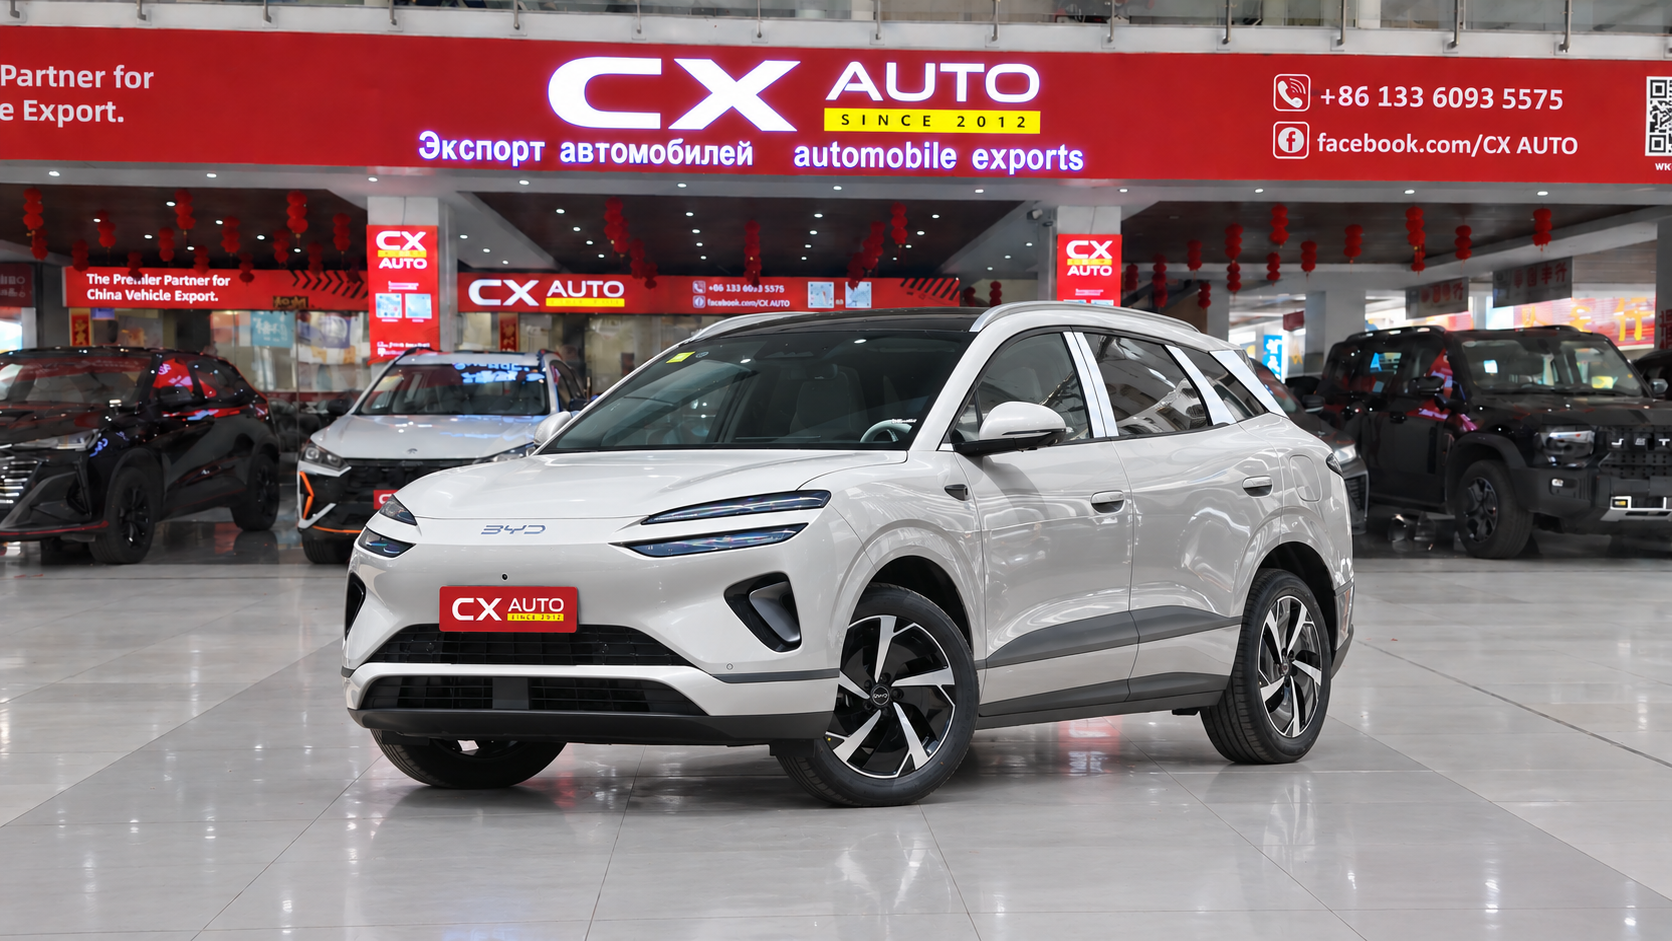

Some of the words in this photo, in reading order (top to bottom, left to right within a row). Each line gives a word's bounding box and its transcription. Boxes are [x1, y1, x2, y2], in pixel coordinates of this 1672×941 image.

[0, 64, 106, 89] Partner
[113, 64, 155, 89] for
[547, 56, 801, 132] CX
[825, 61, 1040, 103] AUTO
[1320, 85, 1370, 108] +86
[1378, 85, 1424, 108] 133
[1432, 86, 1494, 109] 6093
[1502, 88, 1563, 110] 5575
[23, 99, 124, 128] Export.
[841, 114, 932, 127] SINCE
[957, 115, 1027, 128] 2012
[418, 131, 545, 168] Экспорт
[559, 138, 754, 166] автомобилей
[1317, 132, 1511, 158] facebook.com/CX
[1517, 136, 1578, 155] AUTO
[794, 141, 957, 170] automobile
[971, 144, 1084, 176] exports
[375, 230, 427, 251] CX
[1066, 240, 1113, 259] CX
[378, 257, 428, 270] AUTO
[1066, 265, 1113, 277] AUTO
[87, 274, 111, 286] The
[164, 275, 209, 288] Partner
[212, 275, 231, 287] for
[468, 279, 540, 307] CX
[546, 280, 625, 298] AUTO
[87, 288, 123, 301] China
[126, 289, 172, 302] Vehicle
[174, 291, 219, 305] Export.
[481, 524, 547, 535] BYD
[451, 597, 503, 622] CX
[507, 597, 565, 613] AUTO
